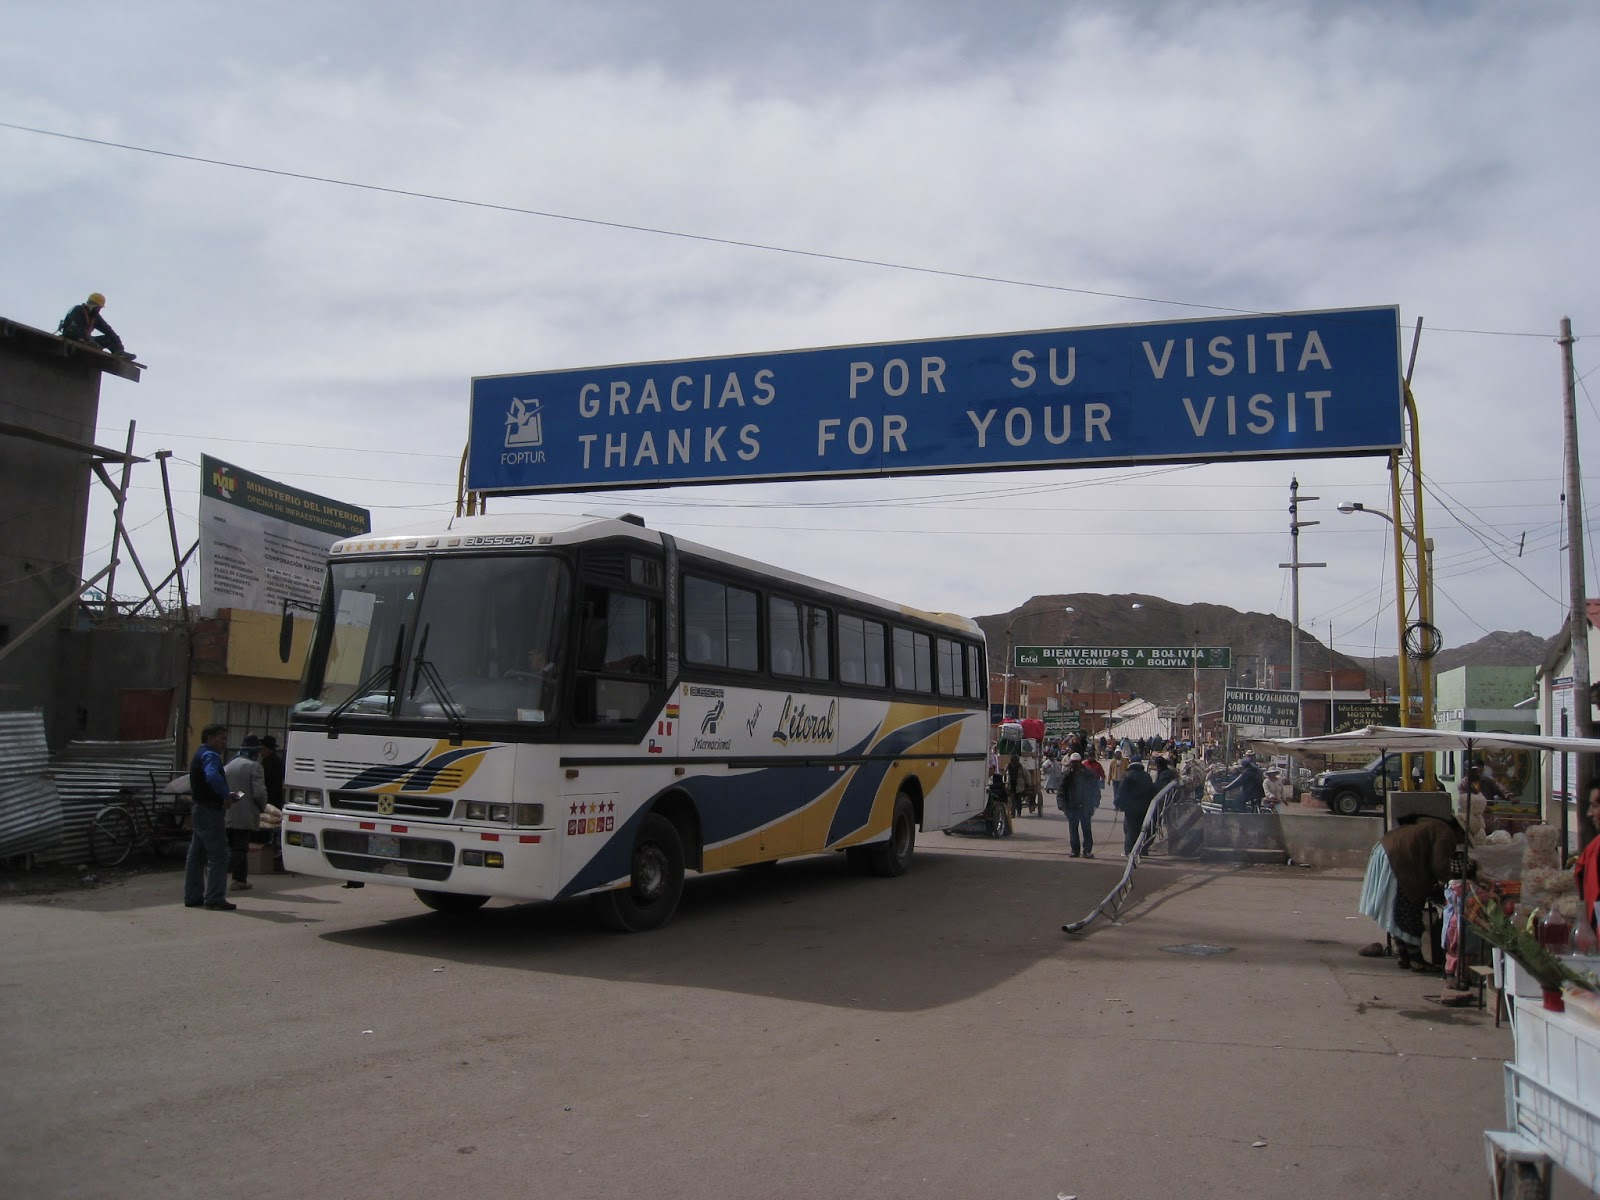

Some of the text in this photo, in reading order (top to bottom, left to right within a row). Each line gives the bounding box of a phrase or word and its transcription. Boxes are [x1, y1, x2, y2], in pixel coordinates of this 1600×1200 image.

[579, 331, 1332, 418] GRACIAS POR SU VISITA
[578, 390, 1332, 469] THANKS FOR YOUR VISIT
[500, 450, 546, 465] FOPTUR
[246, 481, 301, 505] MINISTERIO
[303, 500, 321, 512] DEL
[323, 505, 365, 525] INTERIOR
[1043, 649, 1204, 658] BIENVENIDOS A BOLIVIA
[1056, 658, 1188, 666] WELCOME TO BOLIVIA
[1226, 691, 1254, 701] PUENTE
[1228, 702, 1272, 714] SOBRECARGA
[772, 694, 836, 747] Litoral
[1228, 713, 1264, 724] LONGITUD
[1347, 711, 1383, 719] HOSTAL
